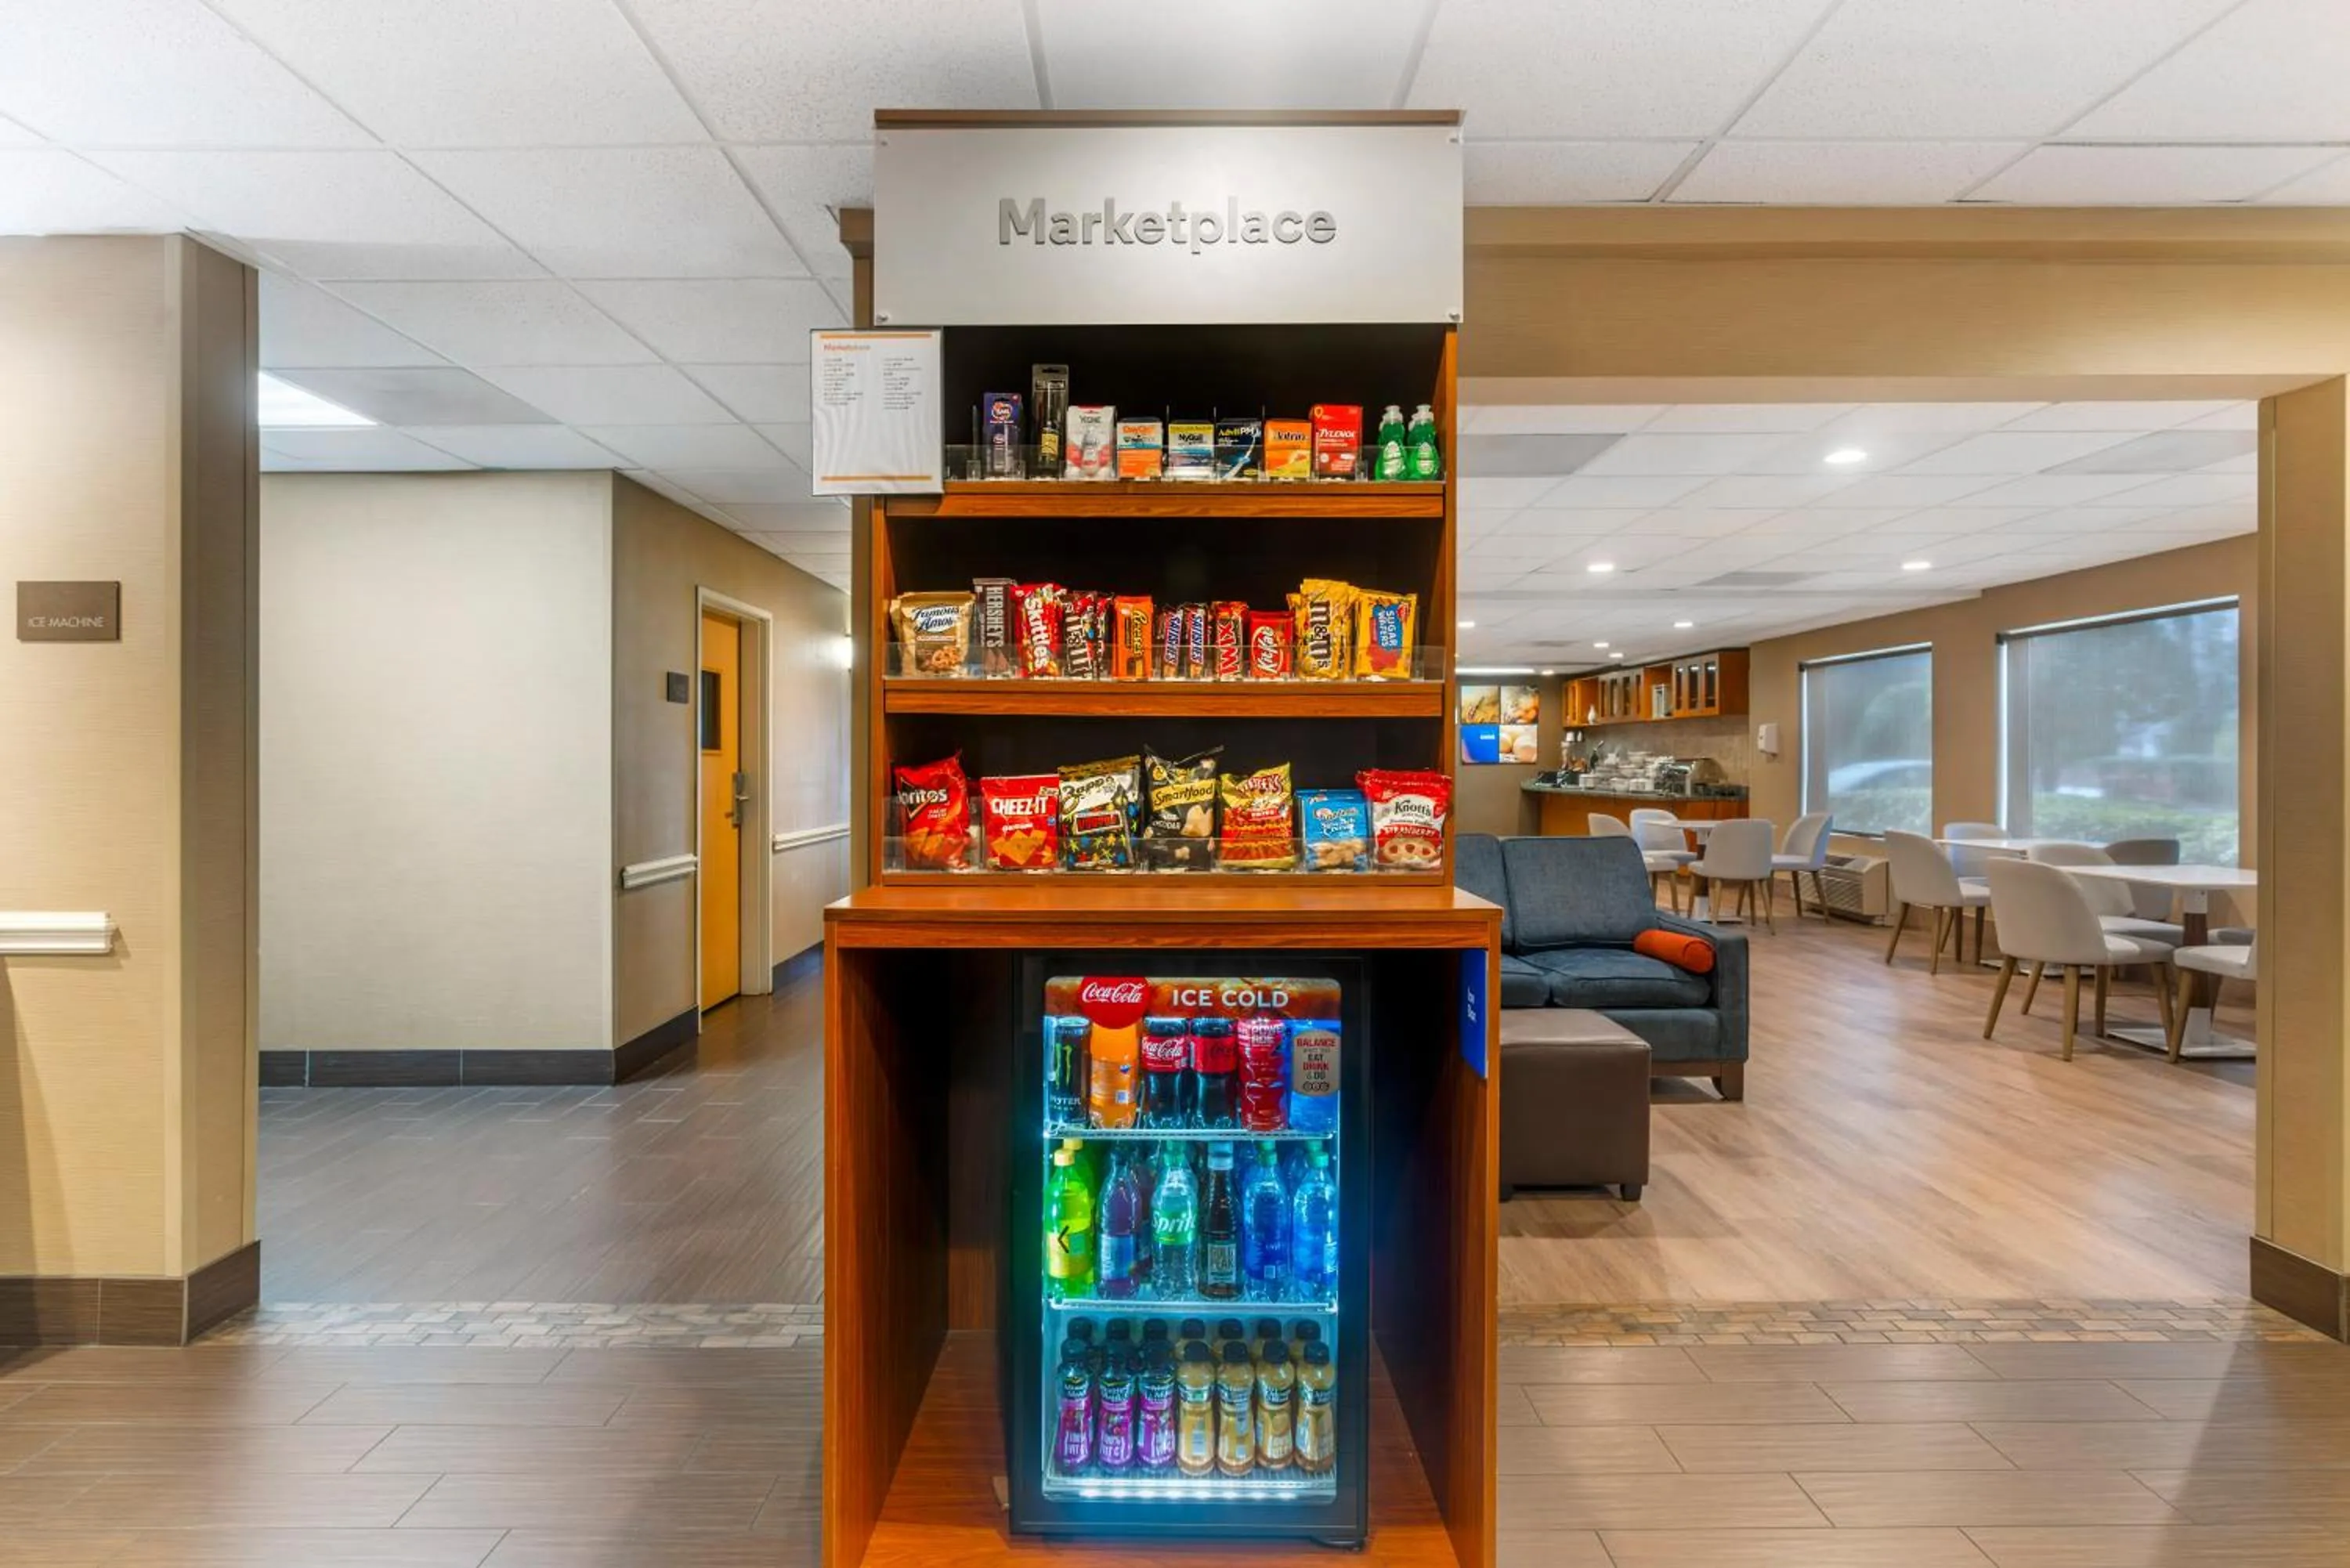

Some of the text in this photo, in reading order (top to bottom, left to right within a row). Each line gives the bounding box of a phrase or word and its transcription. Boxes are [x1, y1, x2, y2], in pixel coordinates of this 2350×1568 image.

[999, 197, 1336, 255] Marketplace
[28, 616, 105, 627] ICE MACHINE
[986, 587, 1003, 649] HERSHEY'S
[1378, 609, 1390, 648] WAFERS
[1386, 609, 1398, 647] SUGAR
[1024, 597, 1050, 669] Skittles
[1154, 784, 1213, 805] Smartfood
[1082, 982, 1146, 1003] Coca-Cola
[1173, 989, 1289, 1007] ICE COLD
[1296, 1037, 1336, 1047] BALANCE
[1303, 1062, 1330, 1071] DRINK
